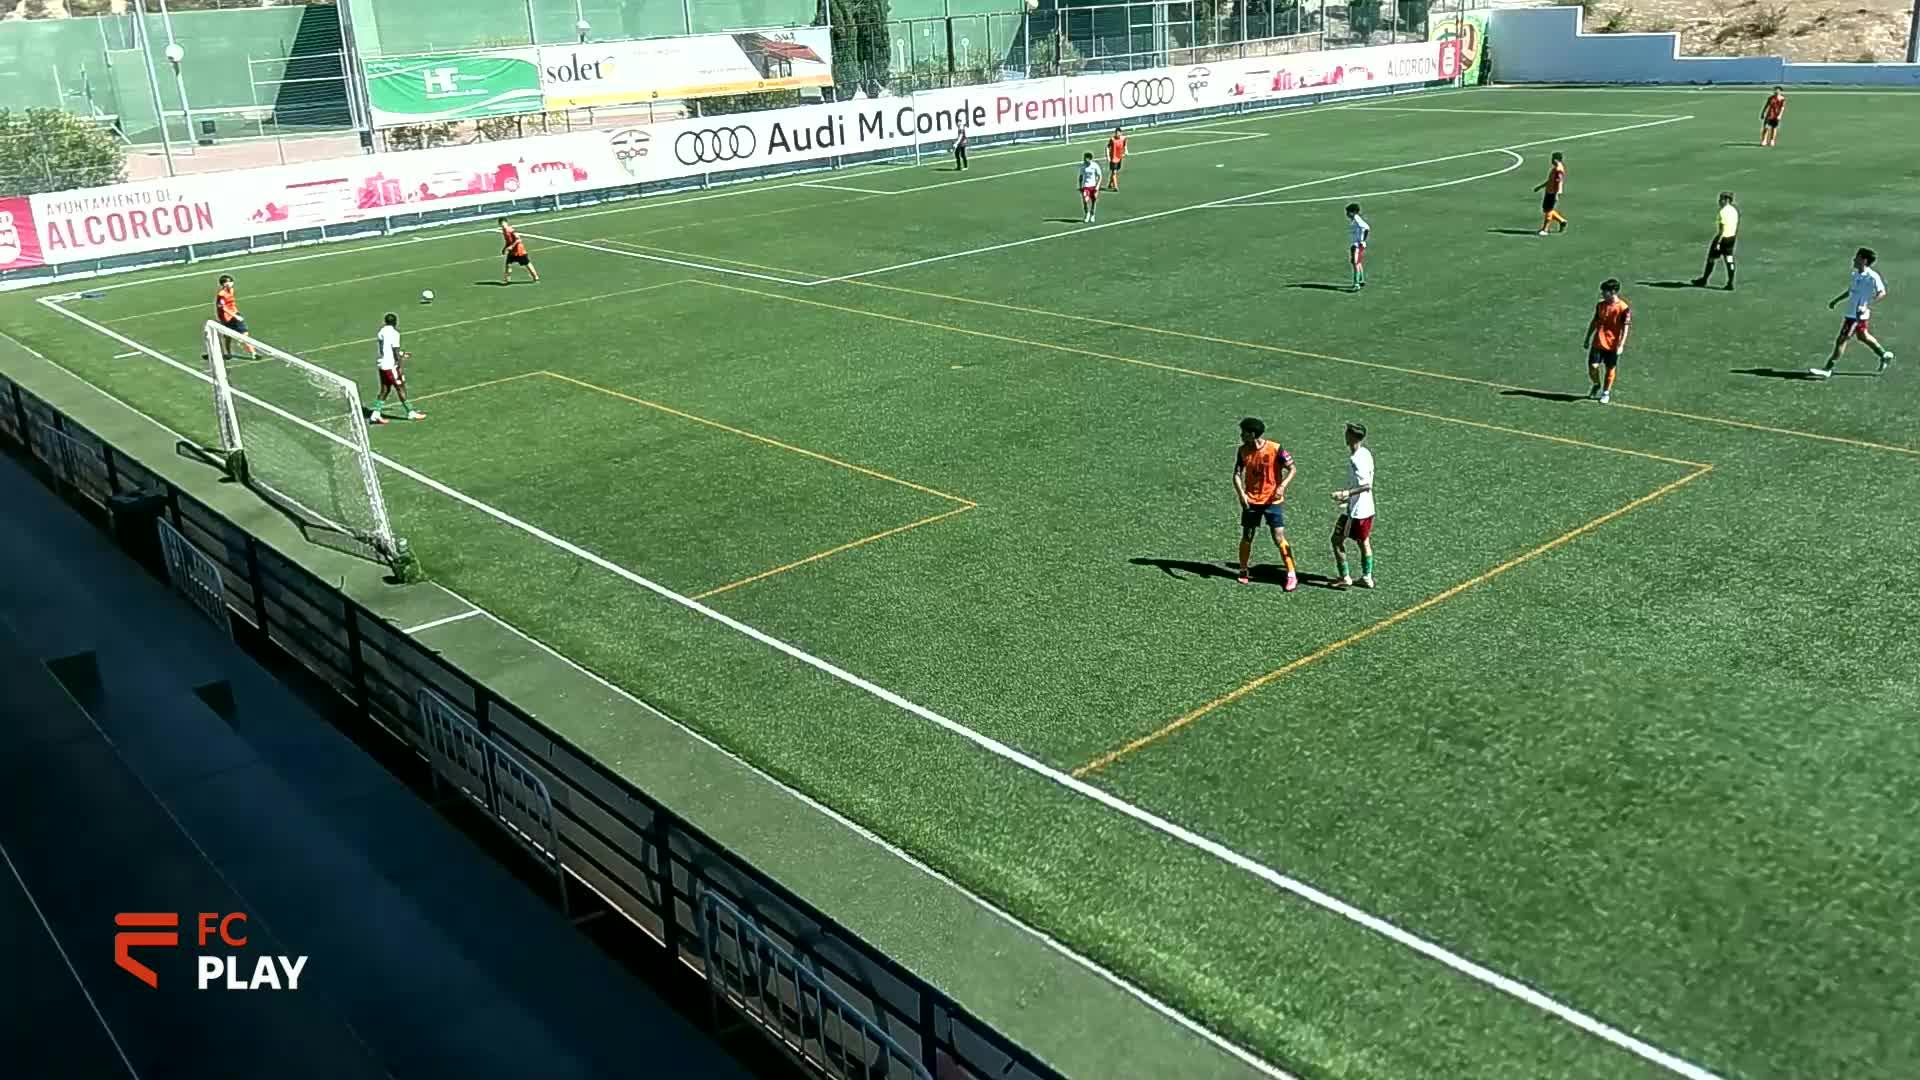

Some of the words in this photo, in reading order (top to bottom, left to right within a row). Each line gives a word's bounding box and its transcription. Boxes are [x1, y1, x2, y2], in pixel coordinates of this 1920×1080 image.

[767, 114, 846, 156] Audi
[858, 98, 986, 142] M.Conde
[995, 88, 1114, 125] Premium
[47, 191, 151, 217] AYUNTAMIENTO
[47, 194, 214, 251] ALCORCÓN
